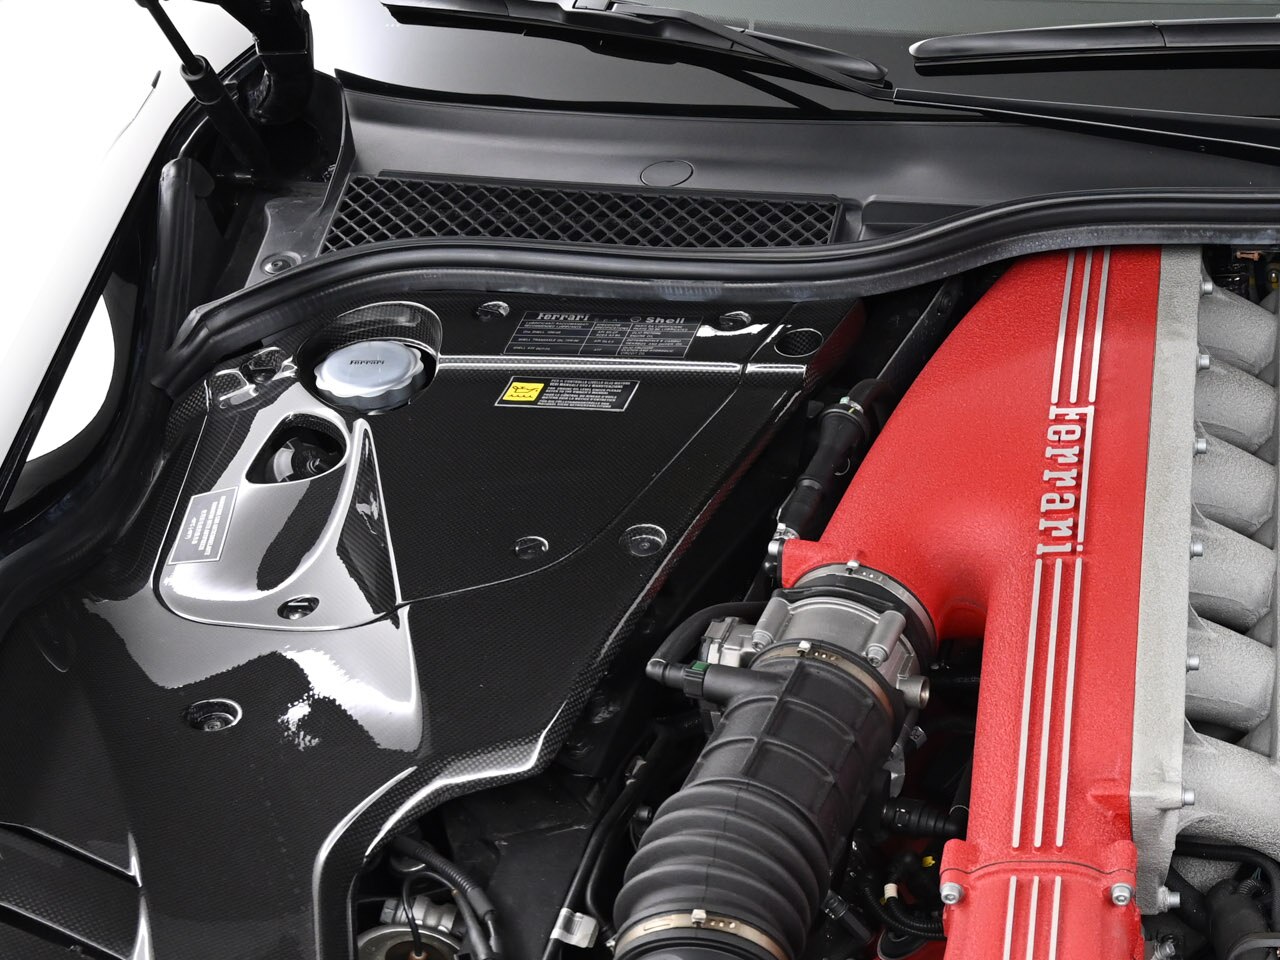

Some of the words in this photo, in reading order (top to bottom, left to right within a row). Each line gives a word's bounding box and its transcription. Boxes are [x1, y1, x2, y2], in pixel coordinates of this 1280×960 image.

[536, 312, 589, 321] Ferrari
[645, 316, 685, 324] Shell
[1036, 405, 1095, 555] Ferrari
